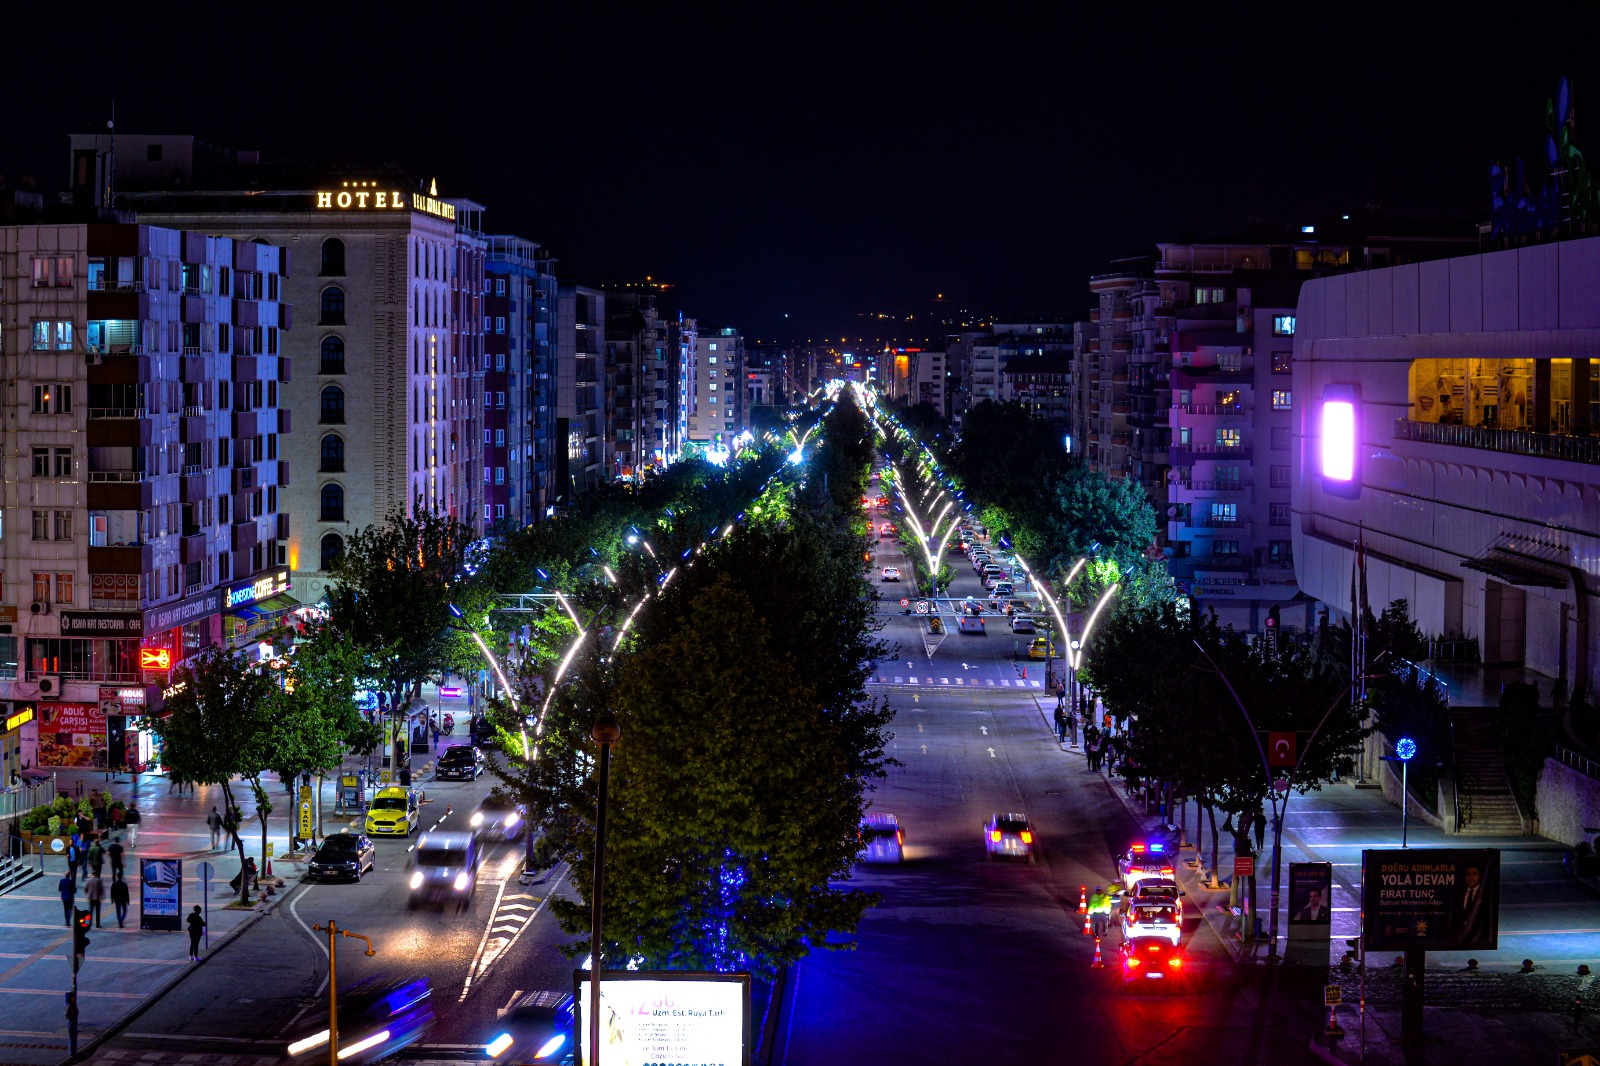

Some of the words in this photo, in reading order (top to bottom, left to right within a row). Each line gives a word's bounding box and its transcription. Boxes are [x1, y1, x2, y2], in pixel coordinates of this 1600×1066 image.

[317, 192, 404, 208] HOTEL
[254, 577, 273, 599] COFFEE
[97, 619, 125, 629] RESTORAN
[123, 689, 144, 698] ADLIĞ
[123, 697, 144, 705] ÇARŞISI
[63, 706, 84, 716] ADLIĞ
[60, 716, 88, 726] ÇARŞISI
[1381, 862, 1409, 872] DOĞRU
[1411, 864, 1456, 872] ADIMLARLA
[1381, 874, 1412, 886] YOLA
[1415, 874, 1455, 886] DEVAM
[1380, 890, 1407, 898] FIRAT
[1409, 890, 1435, 900] TUNÇ
[672, 1009, 687, 1017] Est.
